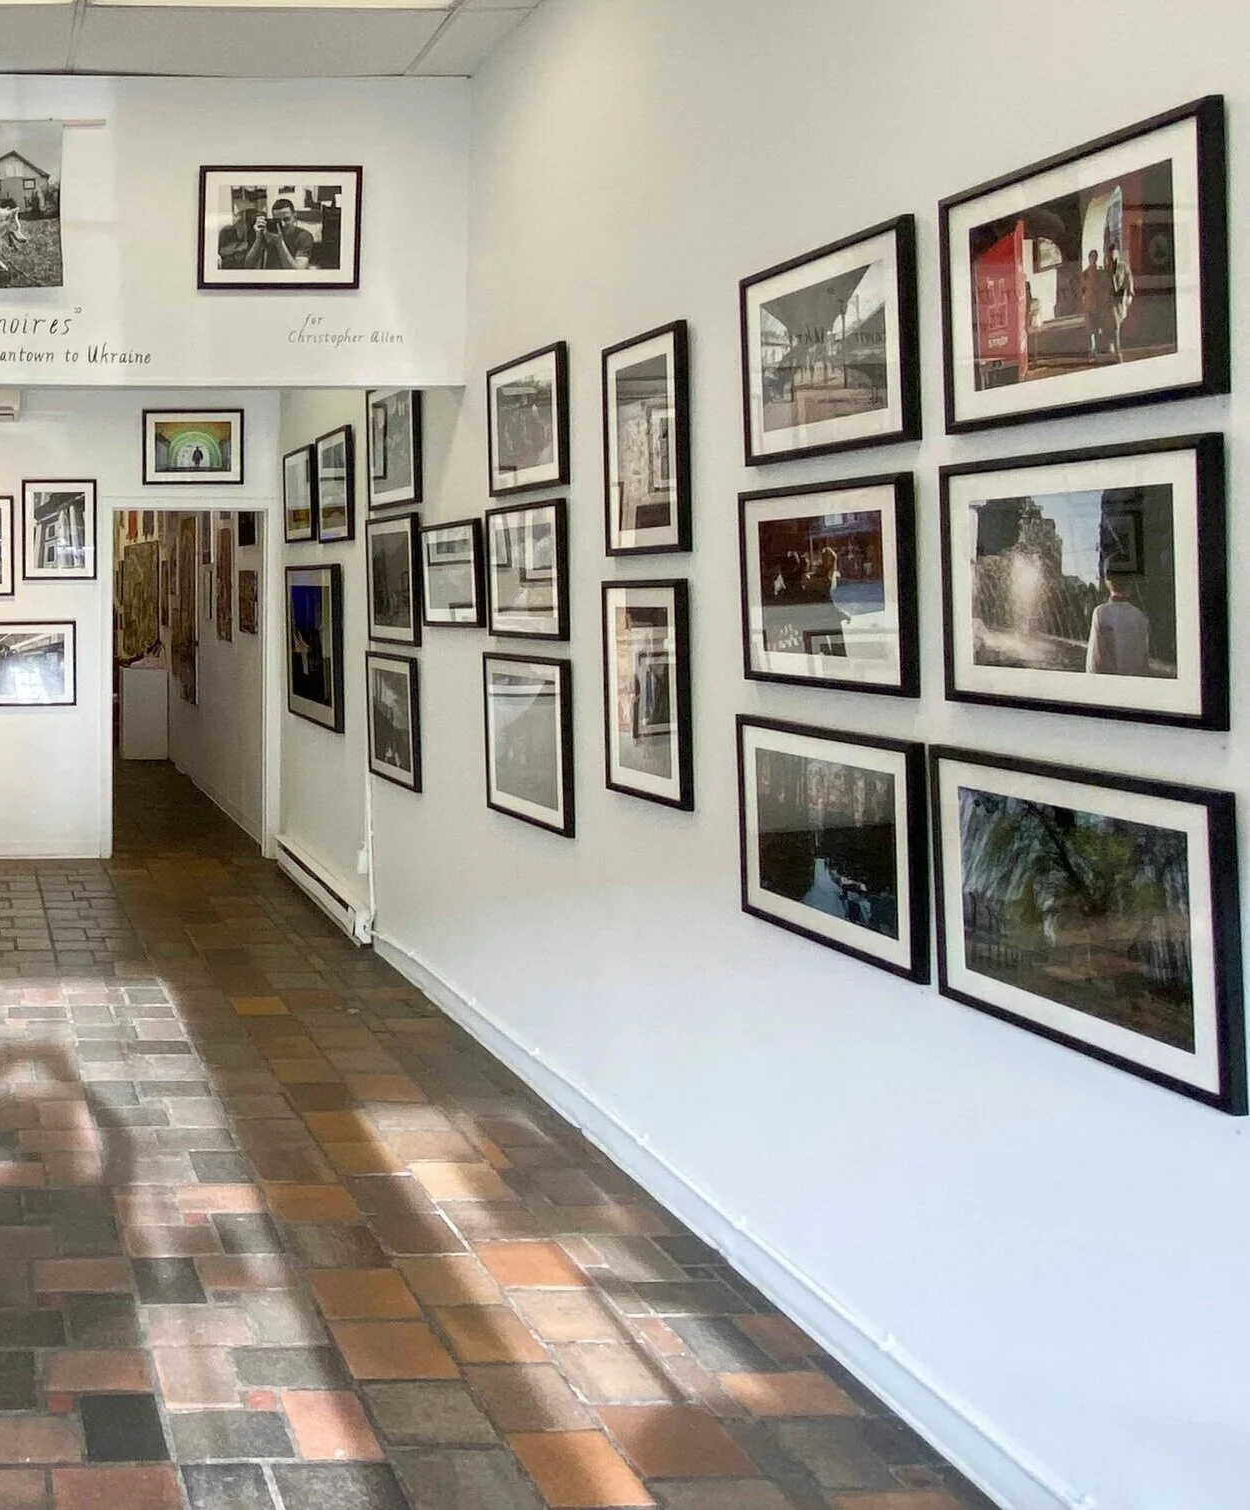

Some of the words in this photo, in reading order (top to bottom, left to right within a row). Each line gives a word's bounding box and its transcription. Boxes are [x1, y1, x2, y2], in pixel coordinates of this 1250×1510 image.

[303, 313, 324, 328] for
[288, 328, 365, 348] Christopher
[65, 349, 80, 363] to
[87, 341, 152, 364] Ukraine
